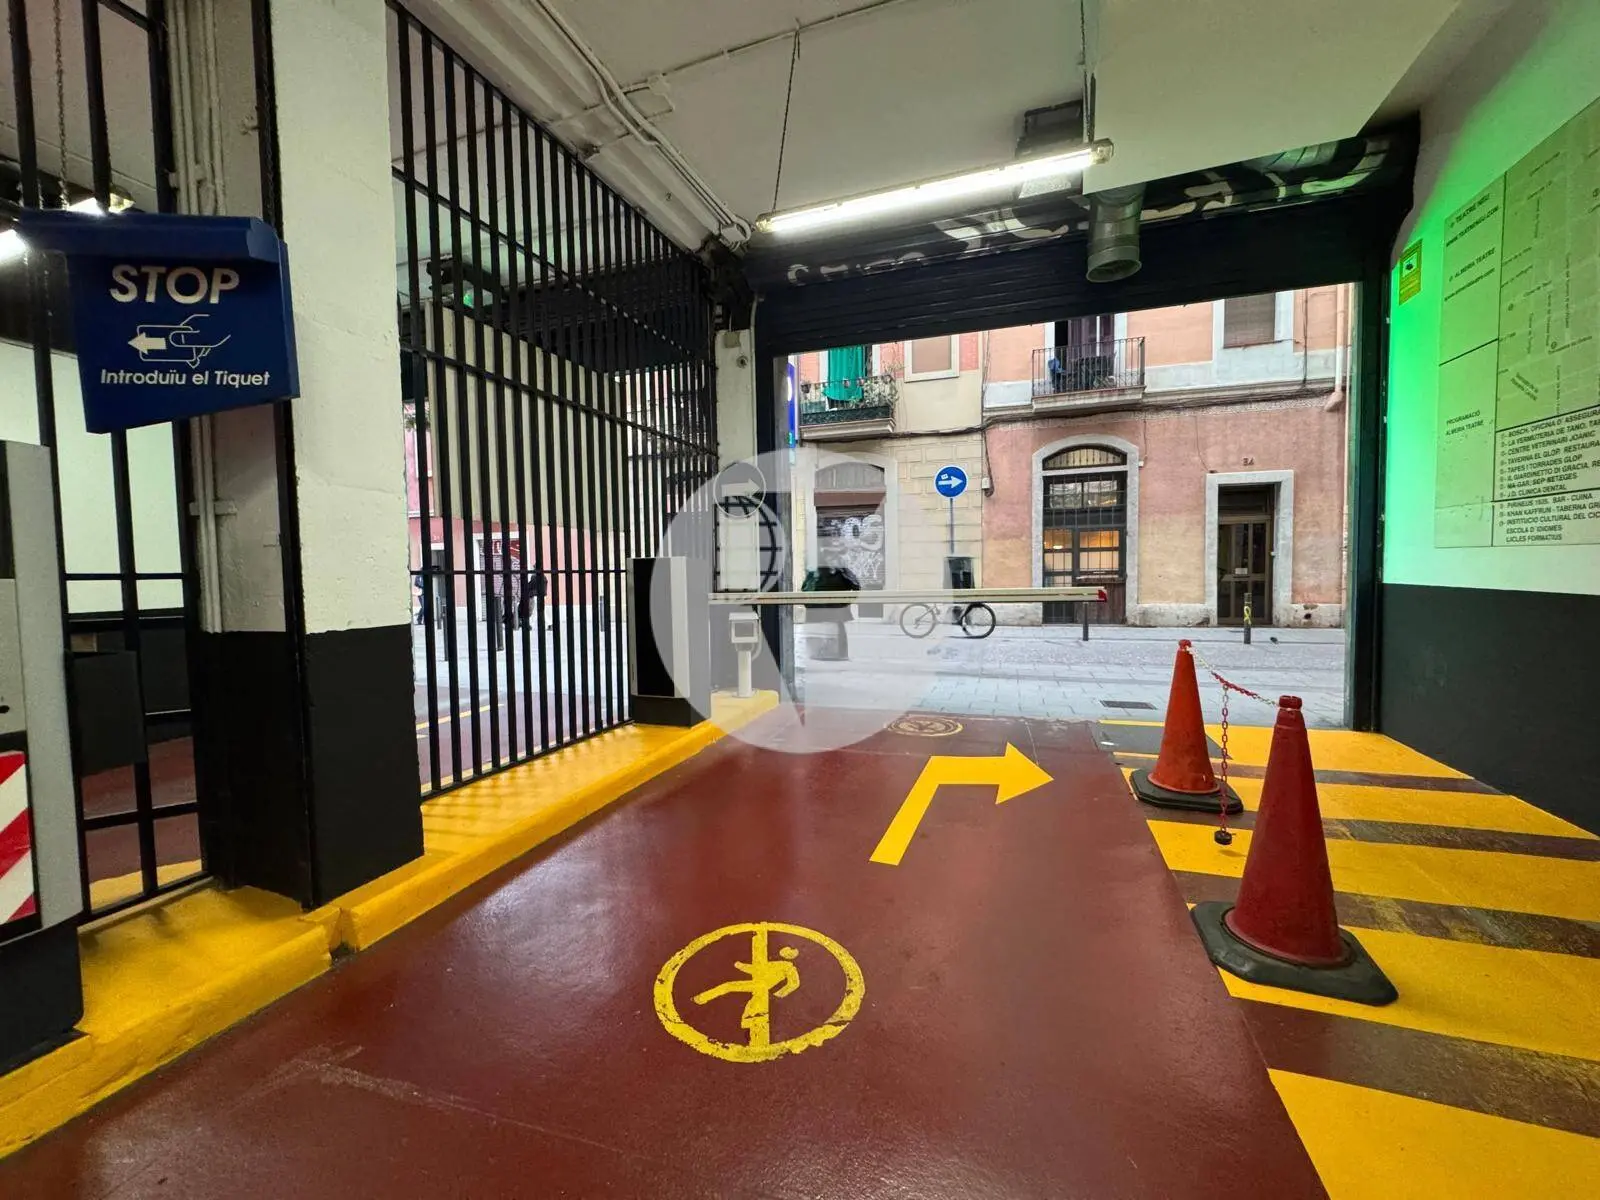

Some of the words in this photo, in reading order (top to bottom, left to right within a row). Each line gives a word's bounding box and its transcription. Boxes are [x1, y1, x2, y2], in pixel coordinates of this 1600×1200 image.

[110, 264, 240, 304] STOP
[101, 368, 186, 386] Introduïu
[192, 370, 208, 385] el
[214, 370, 270, 388] Tiquet
